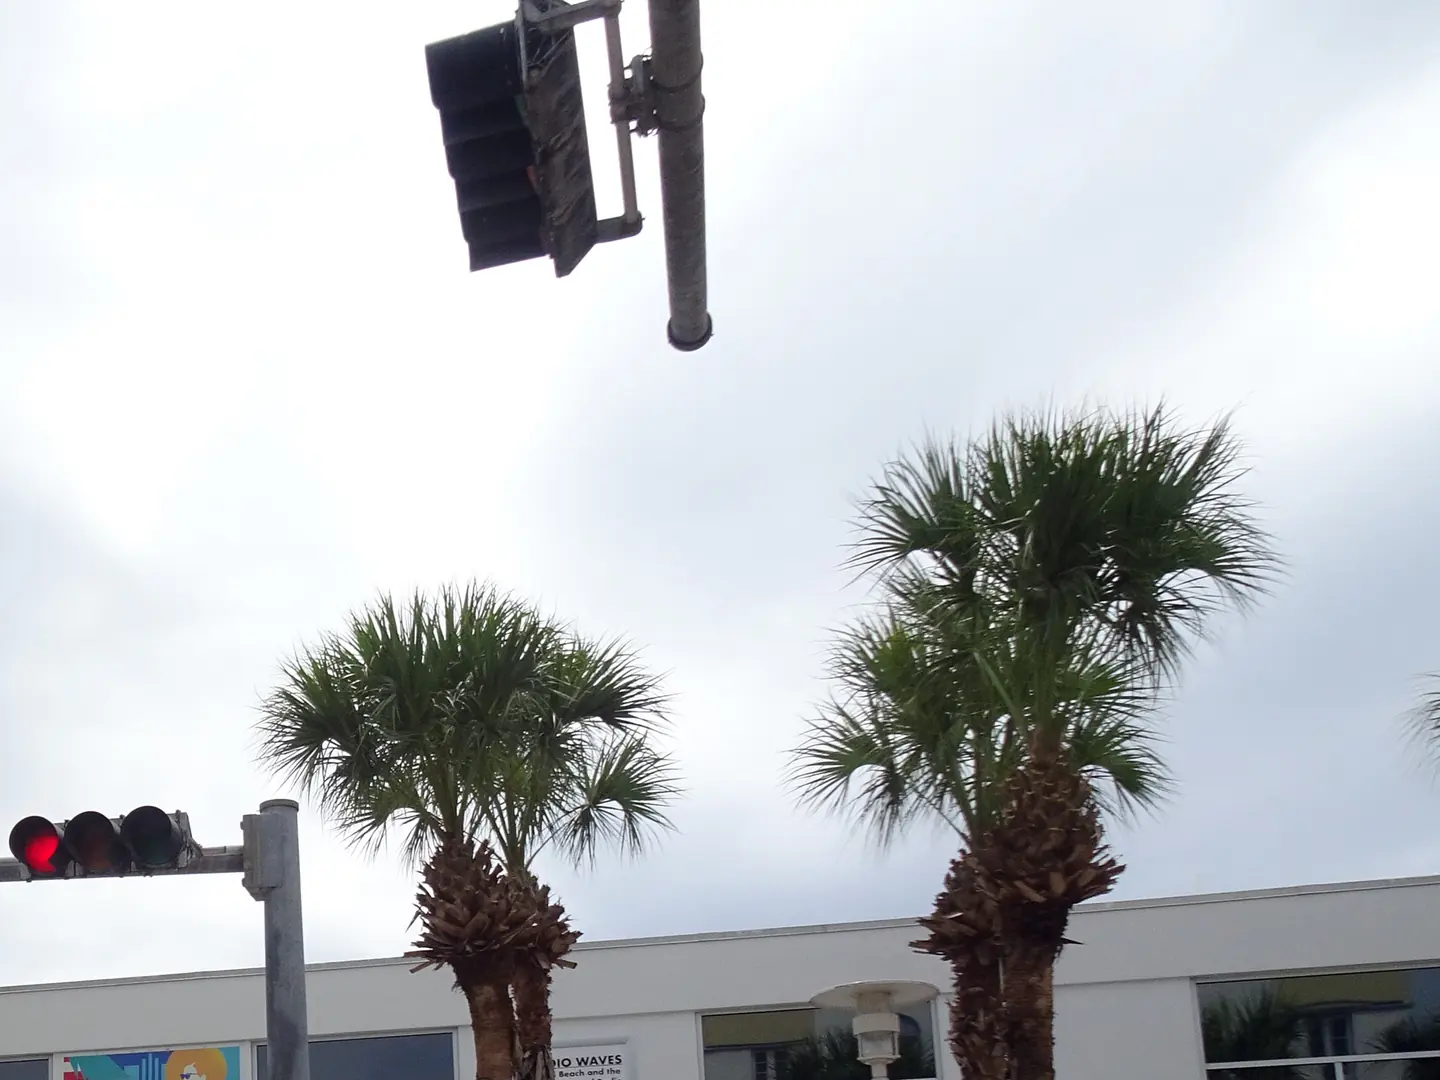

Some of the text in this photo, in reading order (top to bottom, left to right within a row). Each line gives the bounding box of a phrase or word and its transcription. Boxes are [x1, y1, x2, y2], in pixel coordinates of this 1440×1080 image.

[576, 1055, 622, 1066] WAVES
[559, 1070, 585, 1078] Beach
[587, 1068, 604, 1076] and
